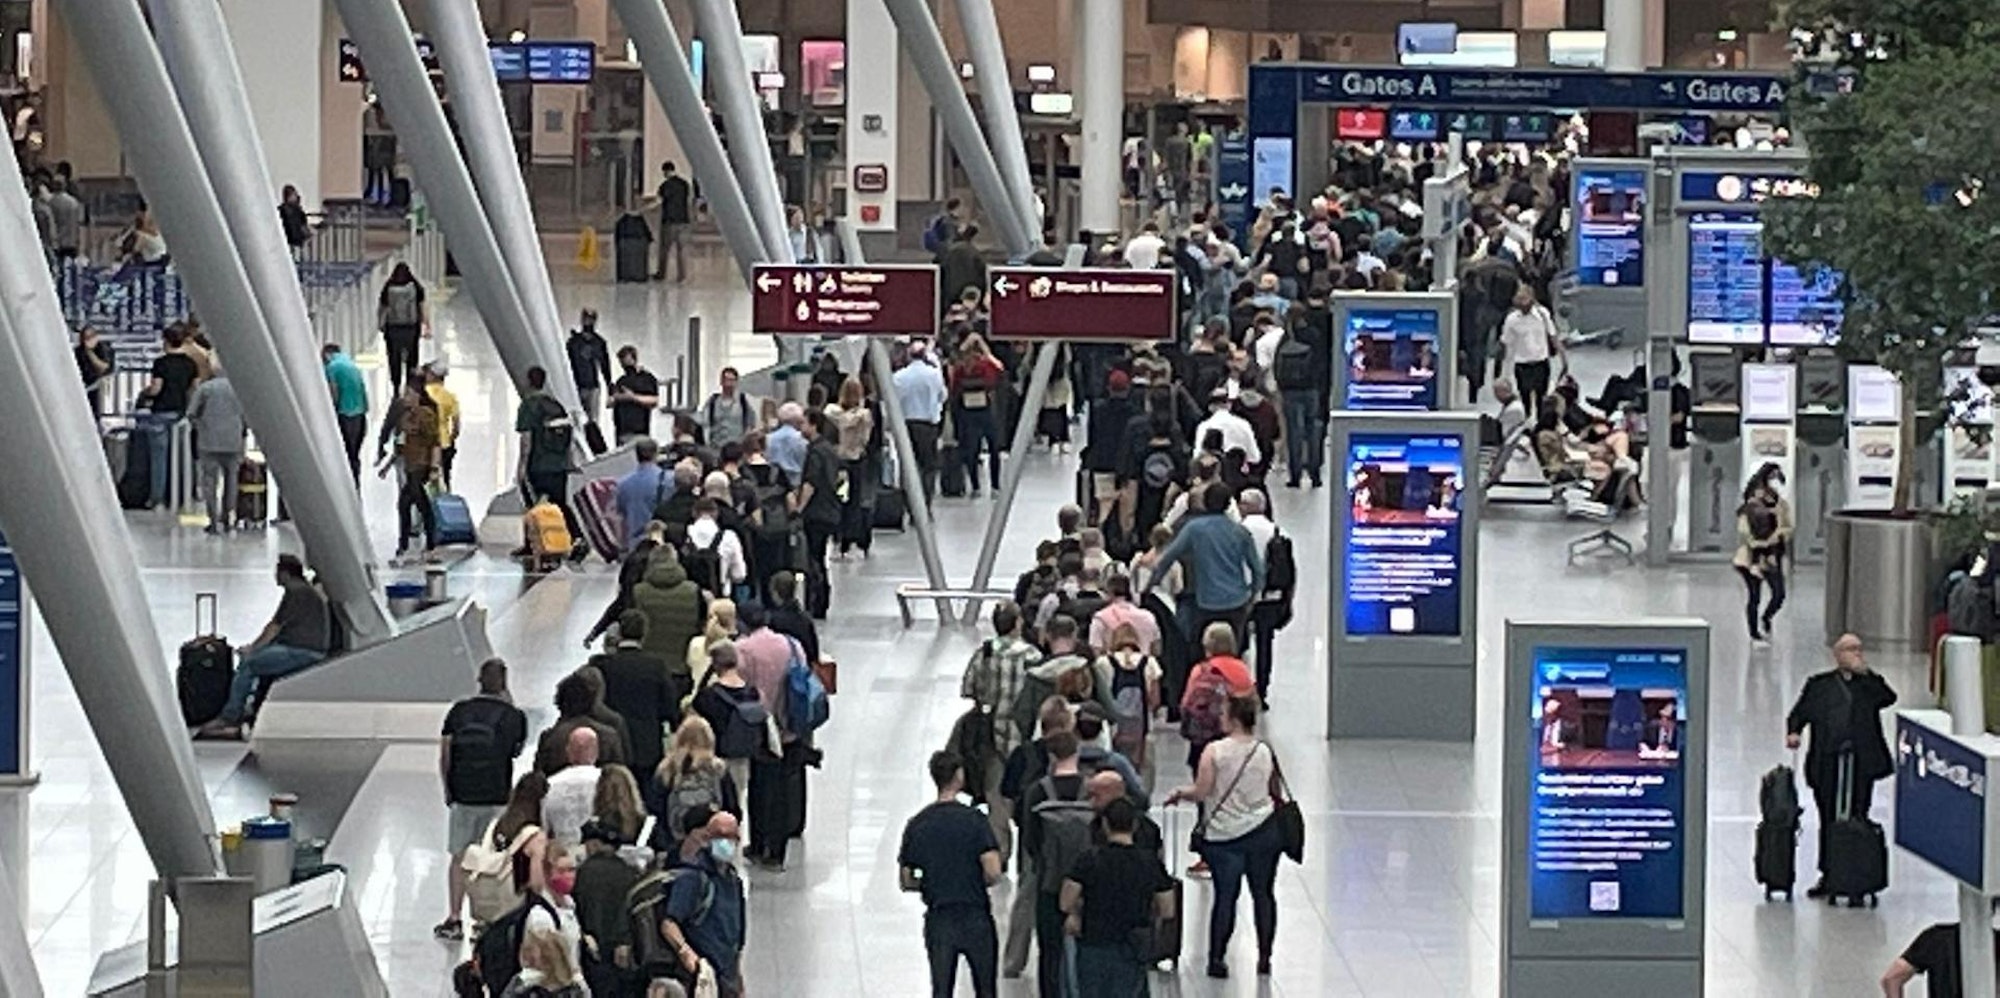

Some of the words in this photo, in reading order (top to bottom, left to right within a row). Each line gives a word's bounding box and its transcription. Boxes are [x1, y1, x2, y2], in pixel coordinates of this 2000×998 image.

[1342, 72, 1414, 96] Gates
[1418, 74, 1437, 96] A
[1686, 79, 1761, 103] Gates
[1764, 81, 1786, 103] A
